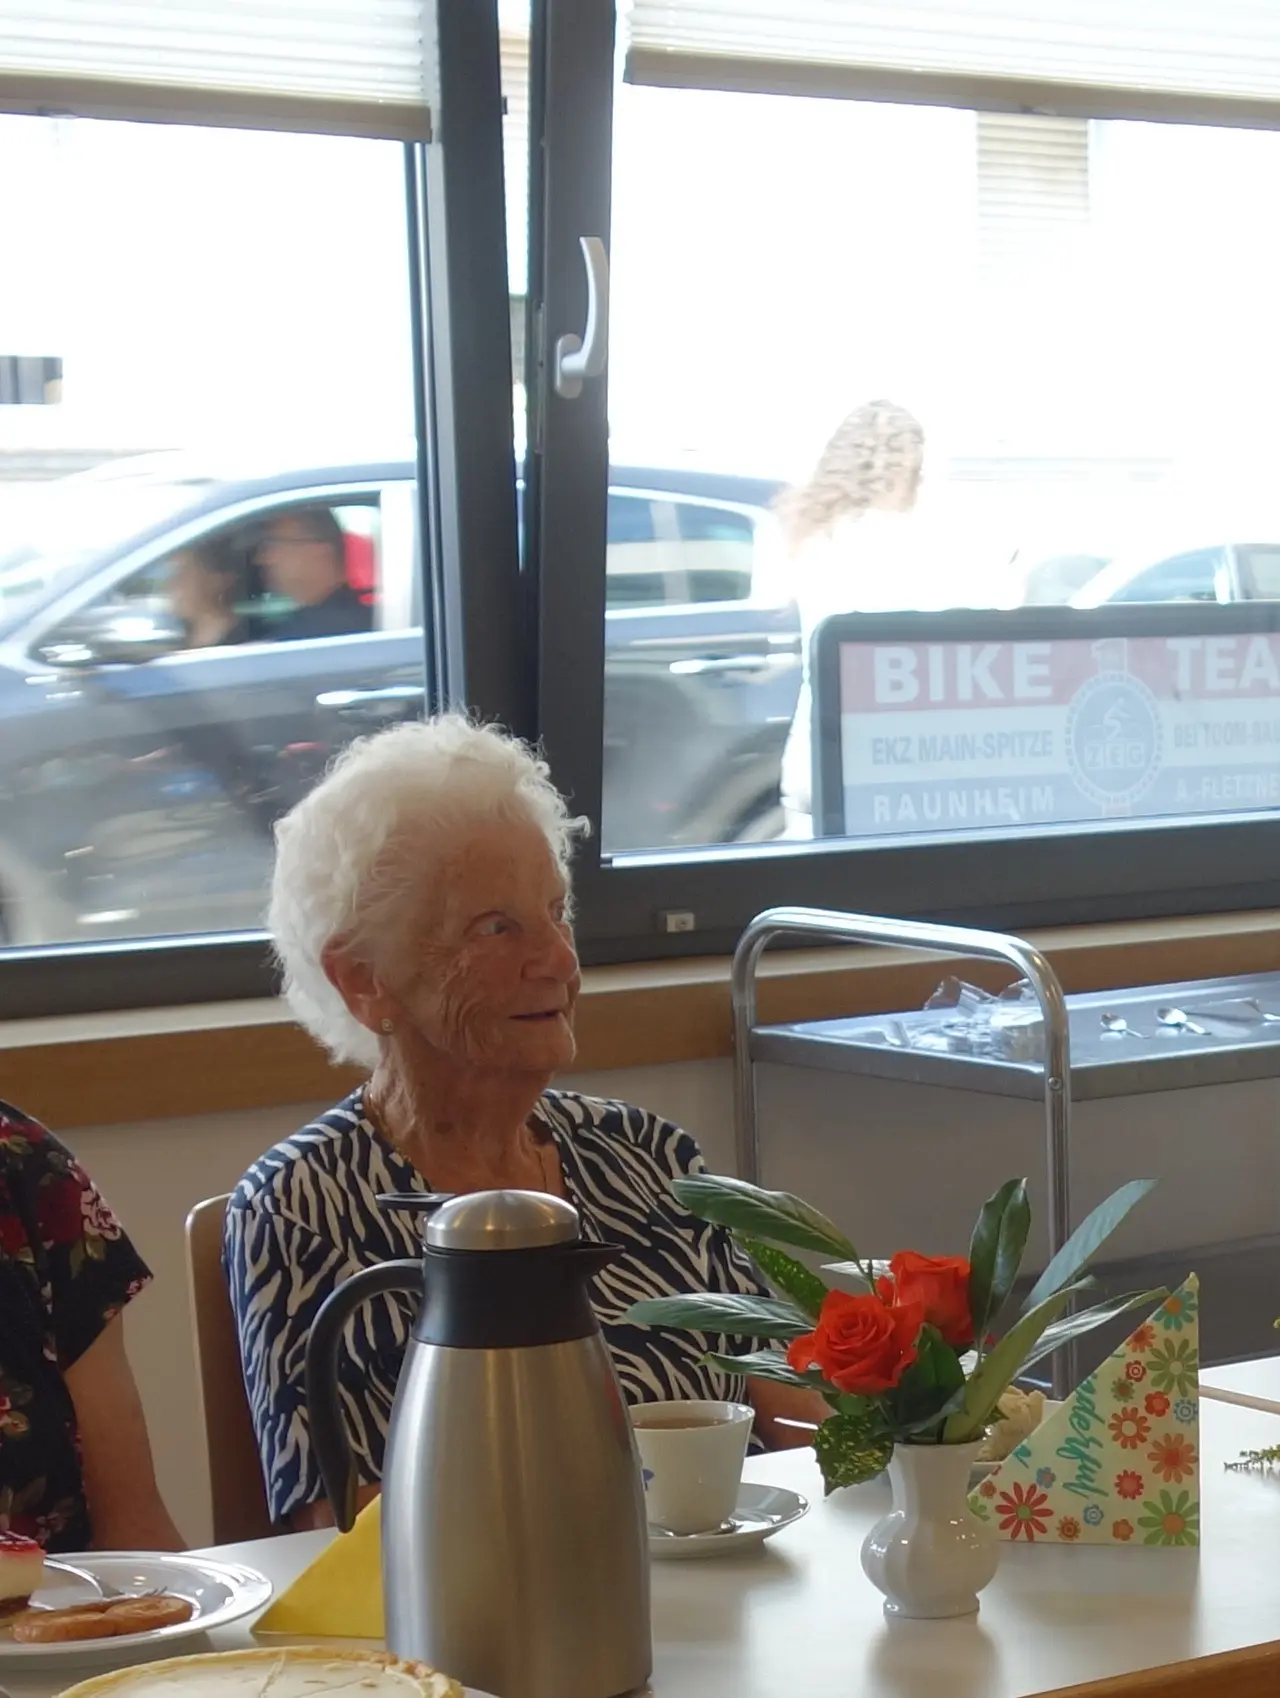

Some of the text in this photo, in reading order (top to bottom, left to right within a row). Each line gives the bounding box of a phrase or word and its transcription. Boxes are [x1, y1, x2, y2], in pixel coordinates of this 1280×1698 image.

[873, 643, 1053, 704] BIKE
[871, 730, 1054, 766] EKZ MAIN-SPITZE
[873, 785, 1055, 823] RAUNHEIM
